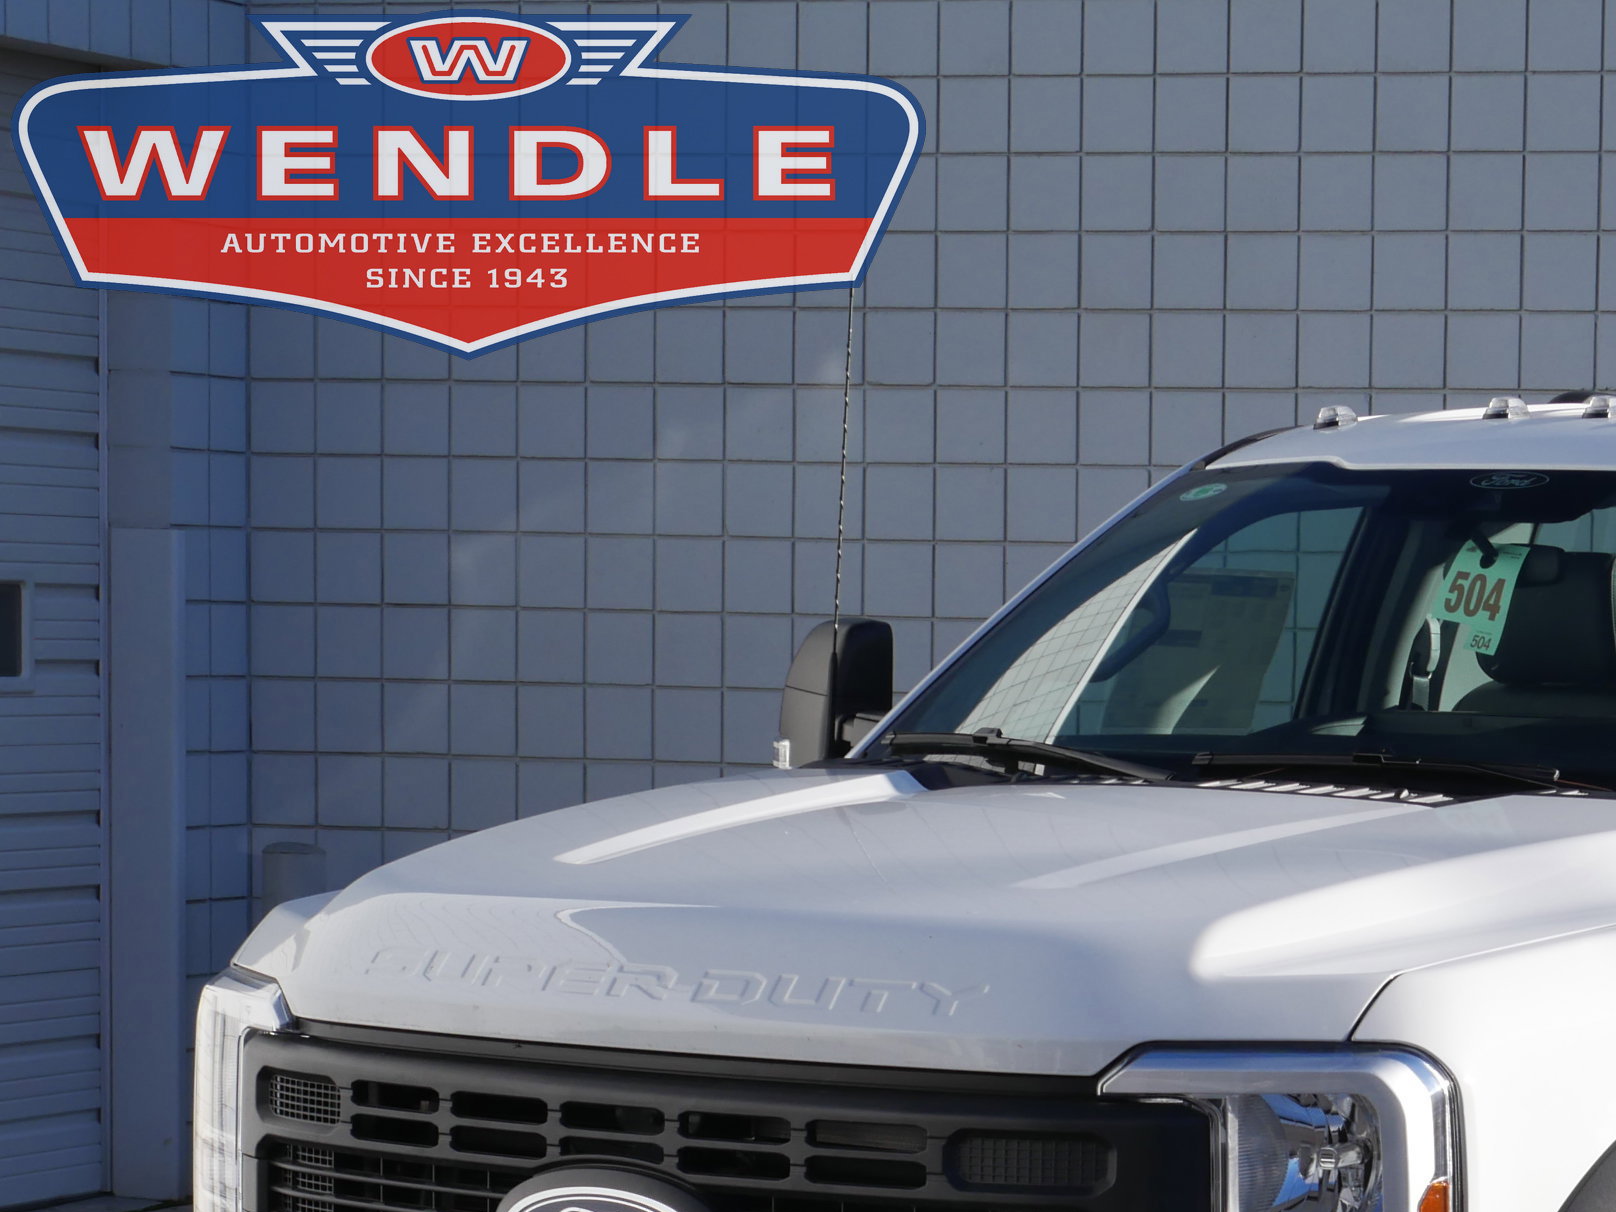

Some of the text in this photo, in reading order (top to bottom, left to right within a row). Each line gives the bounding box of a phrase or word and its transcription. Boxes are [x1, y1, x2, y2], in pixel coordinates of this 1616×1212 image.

[1444, 570, 1506, 622] 504
[1470, 634, 1493, 651] 504
[364, 949, 991, 1017] SUPER DUTY
